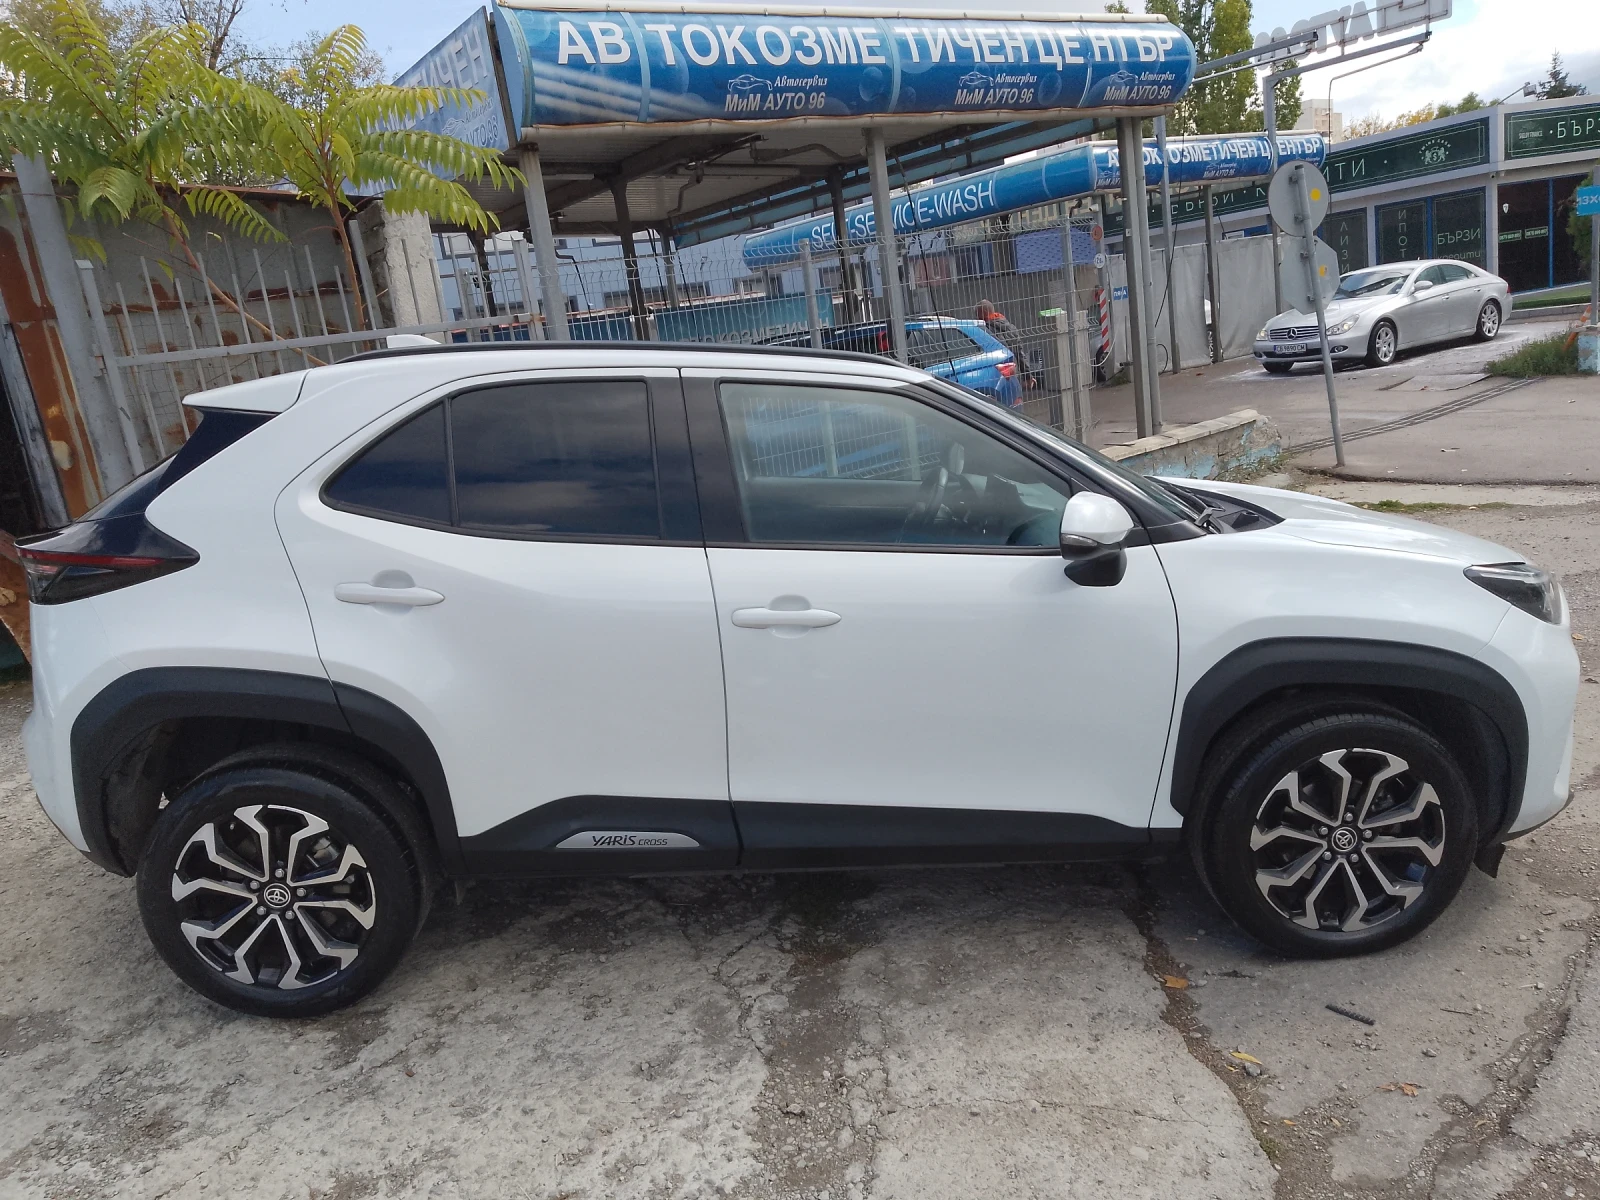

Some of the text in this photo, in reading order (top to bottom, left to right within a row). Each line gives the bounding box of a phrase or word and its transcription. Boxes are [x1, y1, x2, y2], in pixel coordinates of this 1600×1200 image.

[774, 75, 828, 90] Автосервиз
[995, 72, 1038, 86] Автосервиз
[1139, 71, 1176, 84] Автосервиз
[954, 88, 1034, 105] МиМ АУТО 96
[1103, 85, 1172, 101] МиМ АУТО 96
[725, 92, 826, 112] МиМ АУТО 96
[1437, 227, 1481, 245] БЪРЗИ
[638, 838, 668, 846] CROSS
